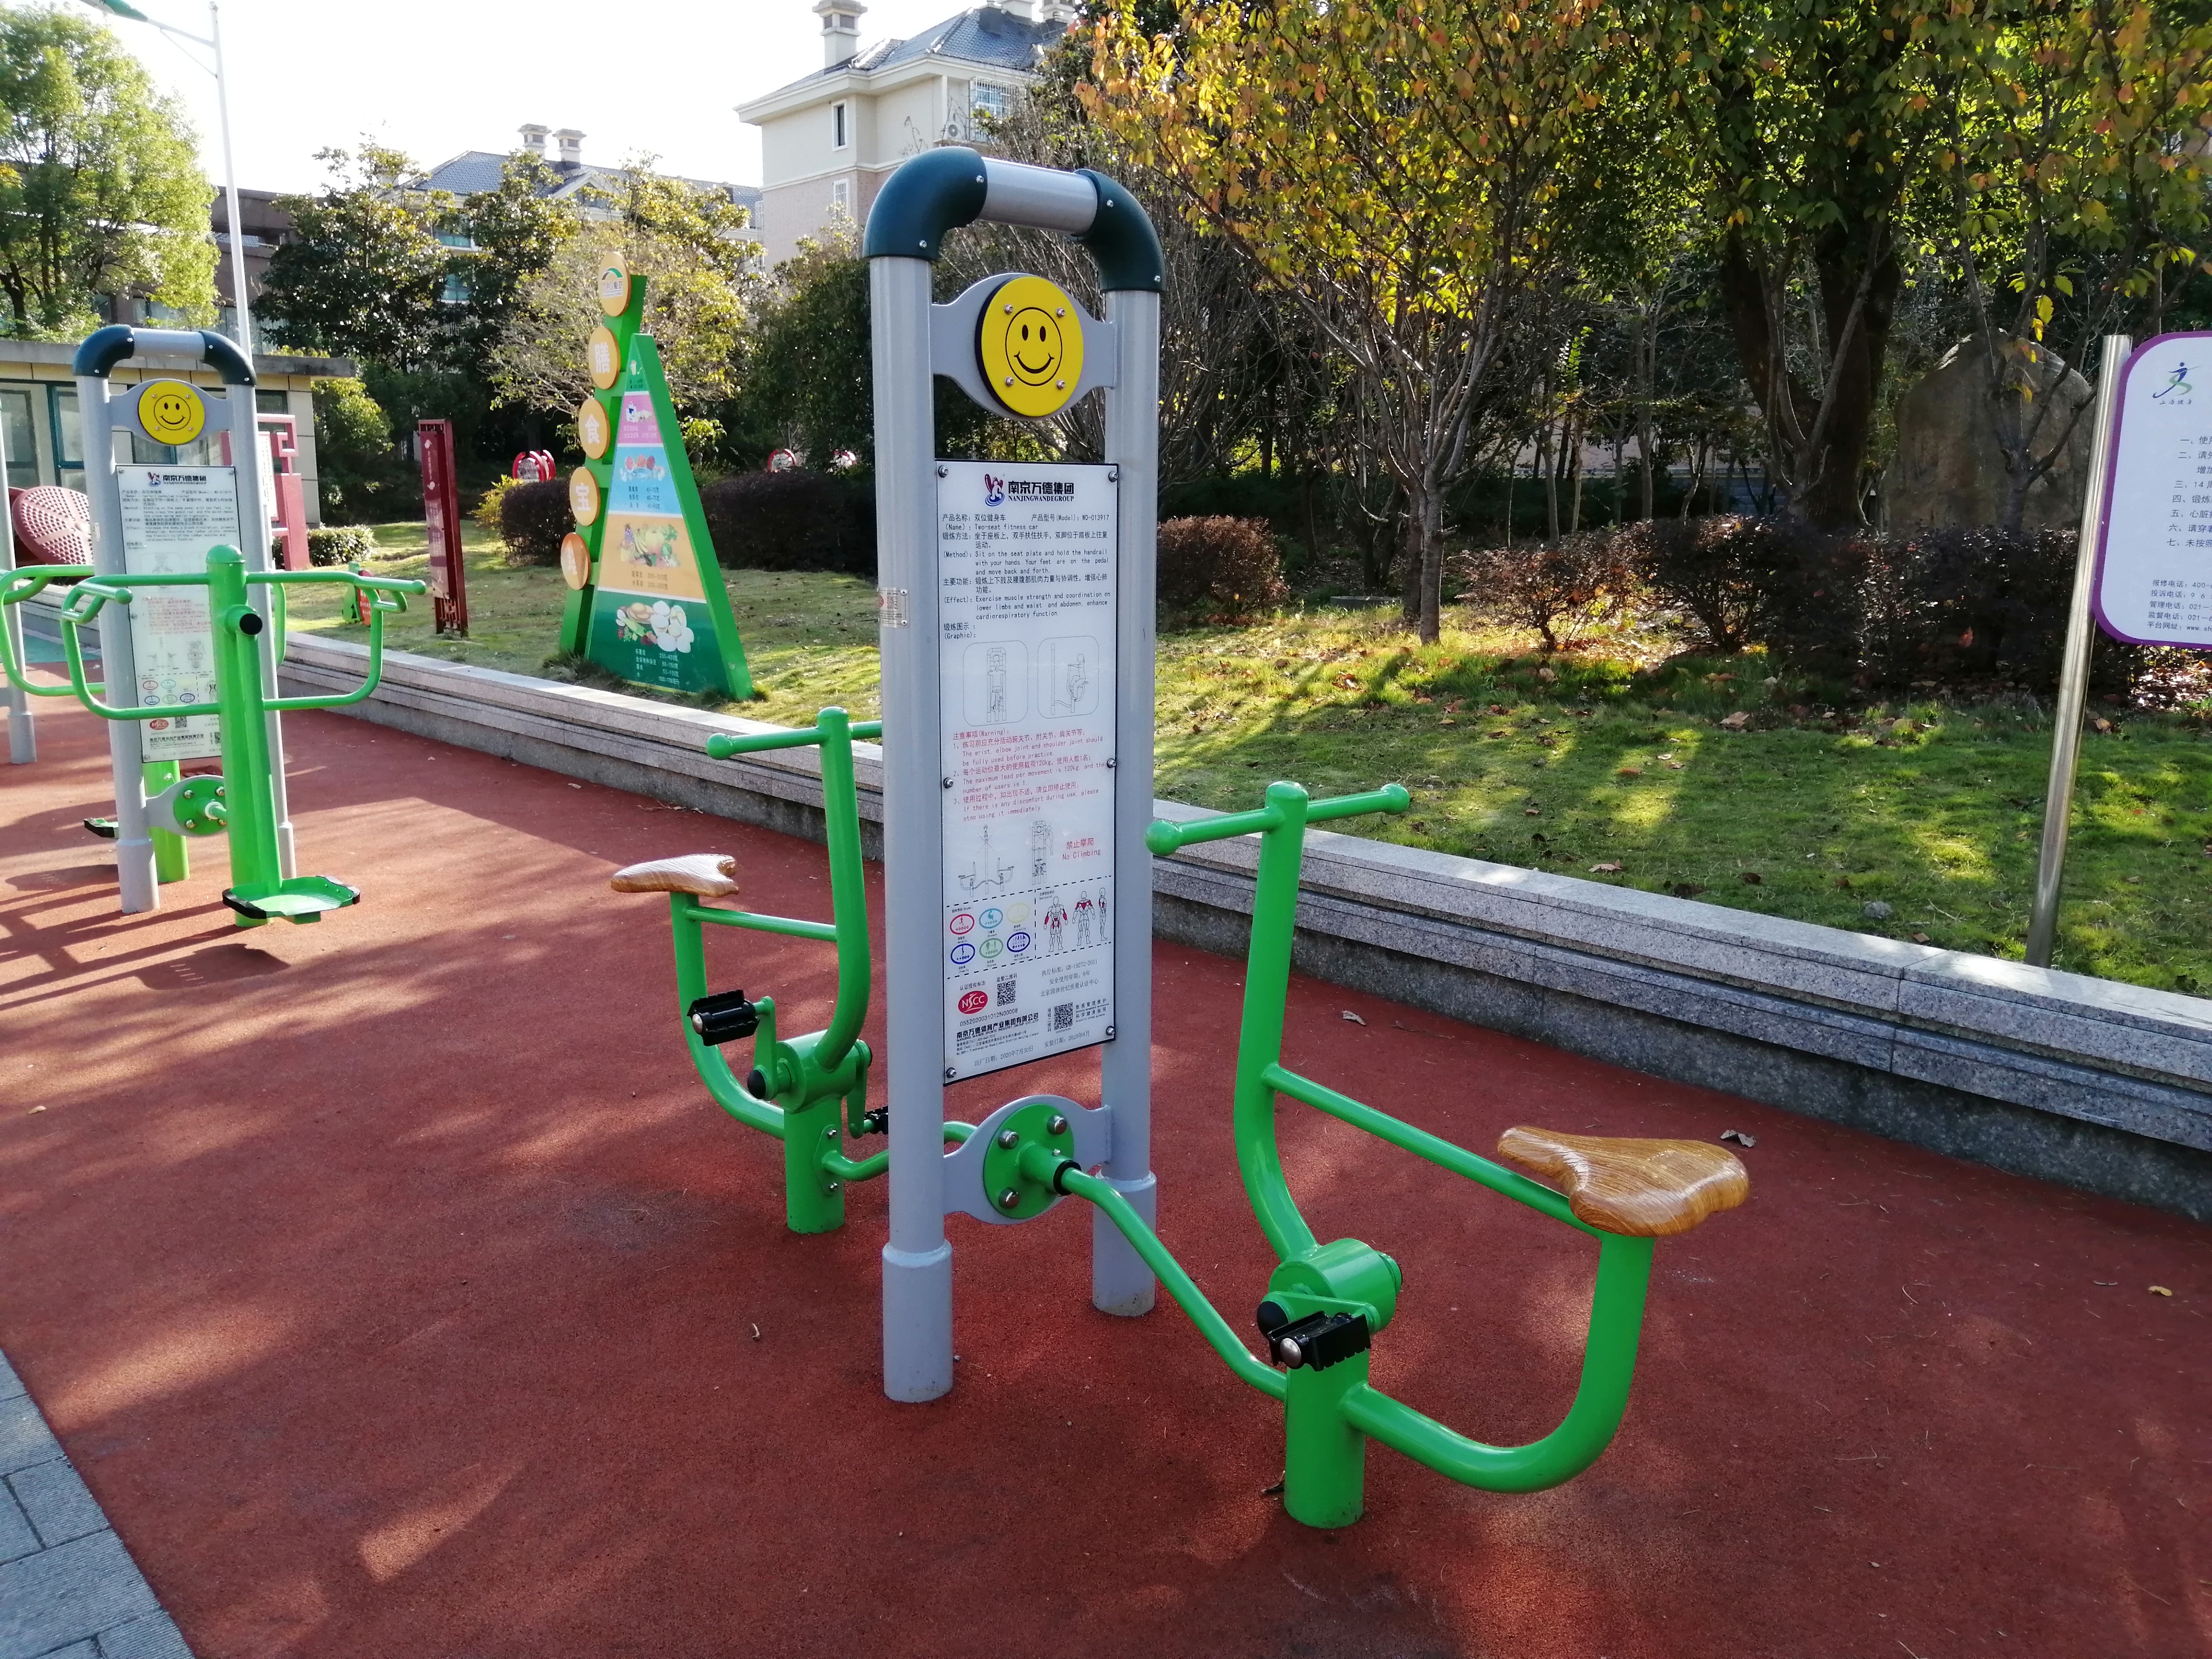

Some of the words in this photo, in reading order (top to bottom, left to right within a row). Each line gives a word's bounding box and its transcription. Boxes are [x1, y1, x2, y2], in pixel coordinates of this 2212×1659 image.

[586, 414, 600, 444] 食
[1008, 481, 1074, 494] 南京万德集团
[576, 482, 591, 511] 宝
[1066, 837, 1094, 850] 禁止攀爬
[1073, 848, 1101, 859] Climbing
[962, 993, 985, 1008] NSCC
[957, 1012, 1039, 1039] 南京万德体育产业集团有限公司
